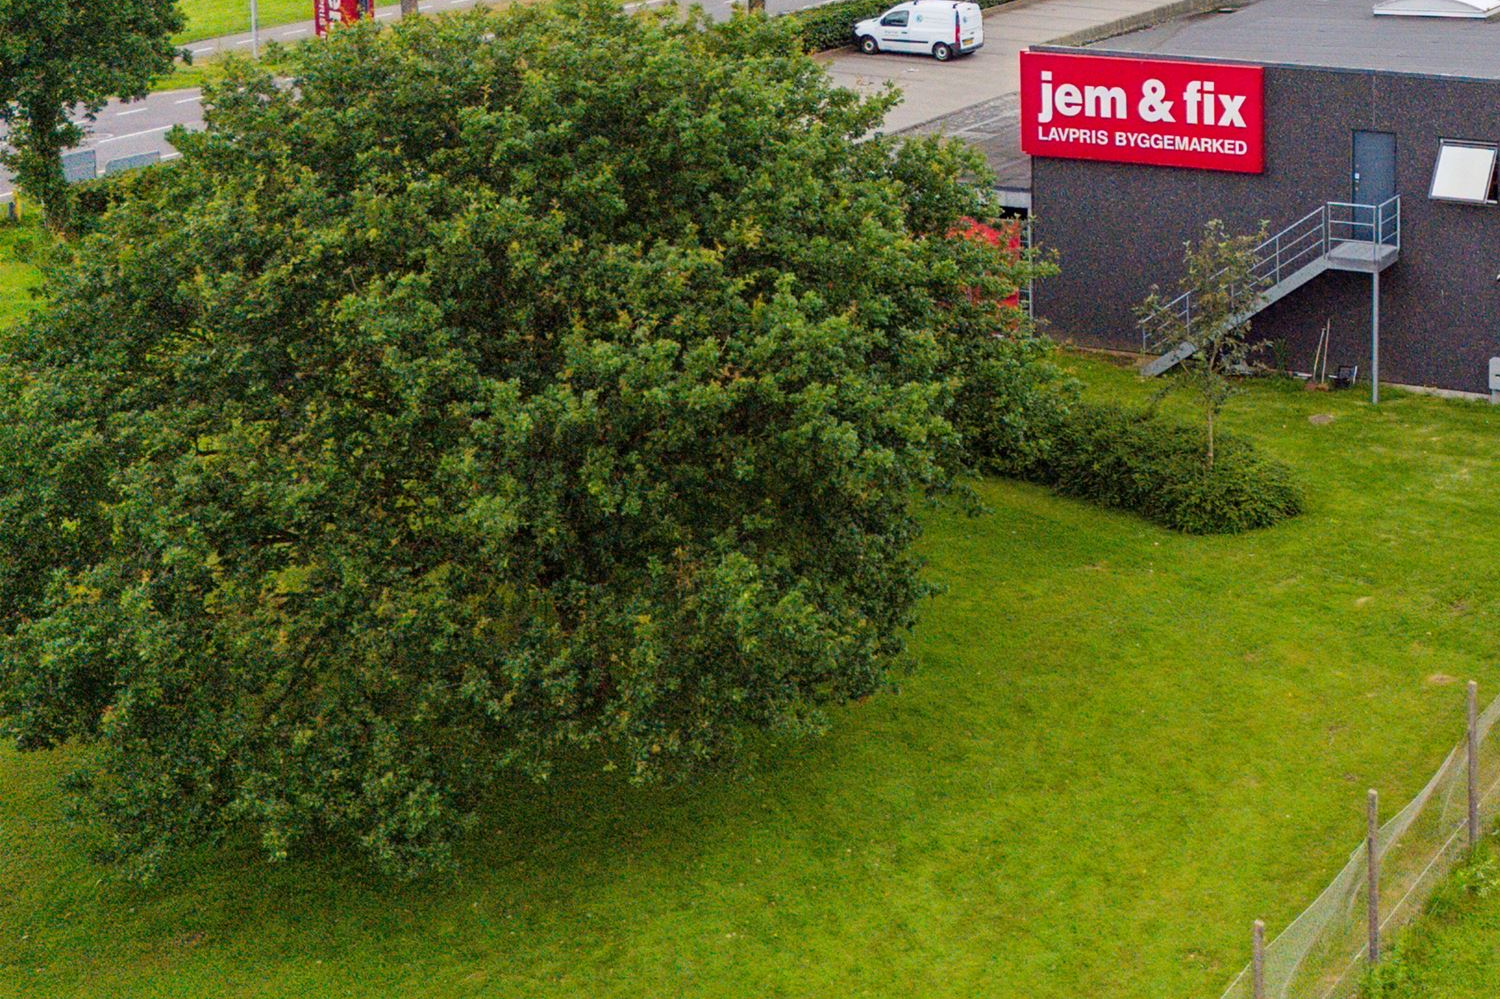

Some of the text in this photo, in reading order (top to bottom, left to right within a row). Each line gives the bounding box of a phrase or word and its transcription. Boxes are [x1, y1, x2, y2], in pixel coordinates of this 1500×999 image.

[1037, 71, 1247, 128] jem & fix
[1037, 126, 1248, 156] LAVPRIS BYGGEMARKED
